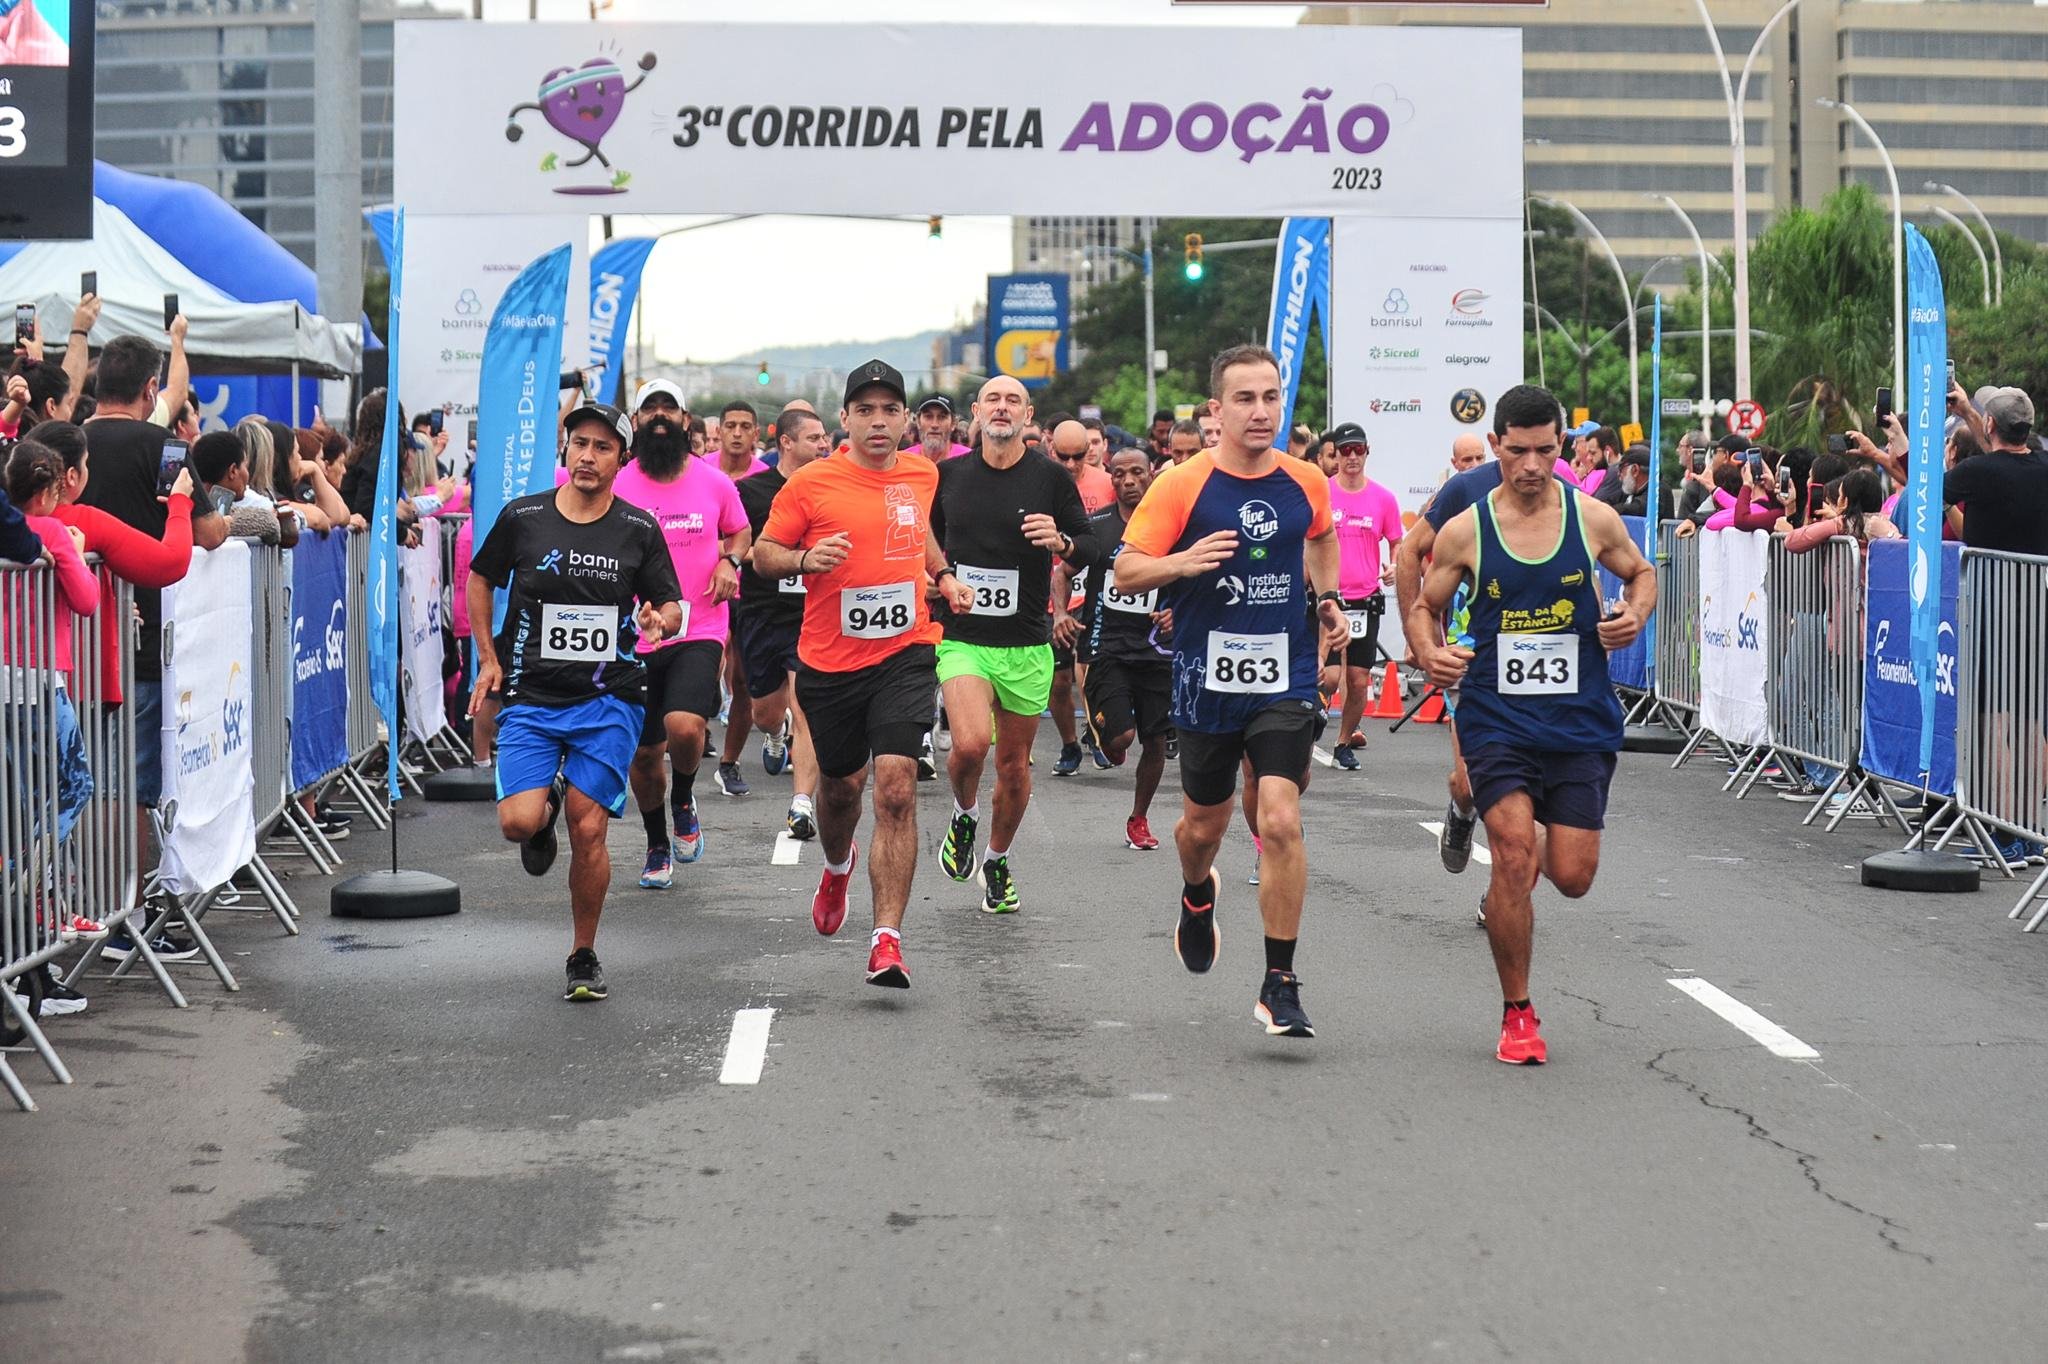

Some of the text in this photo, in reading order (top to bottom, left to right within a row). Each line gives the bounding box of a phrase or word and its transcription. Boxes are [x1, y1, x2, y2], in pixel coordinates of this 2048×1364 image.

[673, 87, 1390, 163] 3ª CORRIDA PELA ADOÇÃO
[1331, 167, 1382, 190] 2023
[442, 317, 490, 329] banrisu
[1370, 316, 1422, 327] banrisul
[1445, 318, 1493, 328] Farroupilha
[586, 272, 624, 399] CATHLON
[455, 349, 482, 360] Sicre
[1383, 347, 1420, 358] Sicredi
[1445, 353, 1490, 366] alegrow
[517, 360, 536, 415] DEUS
[1383, 401, 1421, 412] Zaffari
[519, 419, 536, 444] DE
[1917, 363, 1931, 533] MÃE DE DEUS
[502, 433, 516, 501] HOSPITAL
[516, 504, 543, 515] banrisul
[1238, 506, 1265, 528] Live
[627, 514, 653, 528] banrisul
[1253, 519, 1279, 536] run
[669, 540, 692, 548] nrisul
[569, 549, 619, 570] banri
[568, 567, 619, 582] runners
[967, 571, 985, 582] Sesc
[1248, 572, 1291, 587] Instituto
[856, 593, 879, 601] Sesc
[976, 587, 1011, 609] 38
[1247, 582, 1291, 599] Méderi
[556, 611, 580, 621] Sesc
[848, 604, 909, 631] 948
[1534, 607, 1550, 617] DA
[549, 627, 609, 652] 850
[1737, 611, 1759, 651] Sesc
[326, 624, 344, 672] Sesc
[1223, 640, 1248, 651] Sesc
[1513, 641, 1539, 651] Sesc
[1215, 656, 1280, 684] 863
[1506, 657, 1569, 685] 843
[1935, 652, 1955, 696] esc
[223, 698, 243, 756] Sesc
